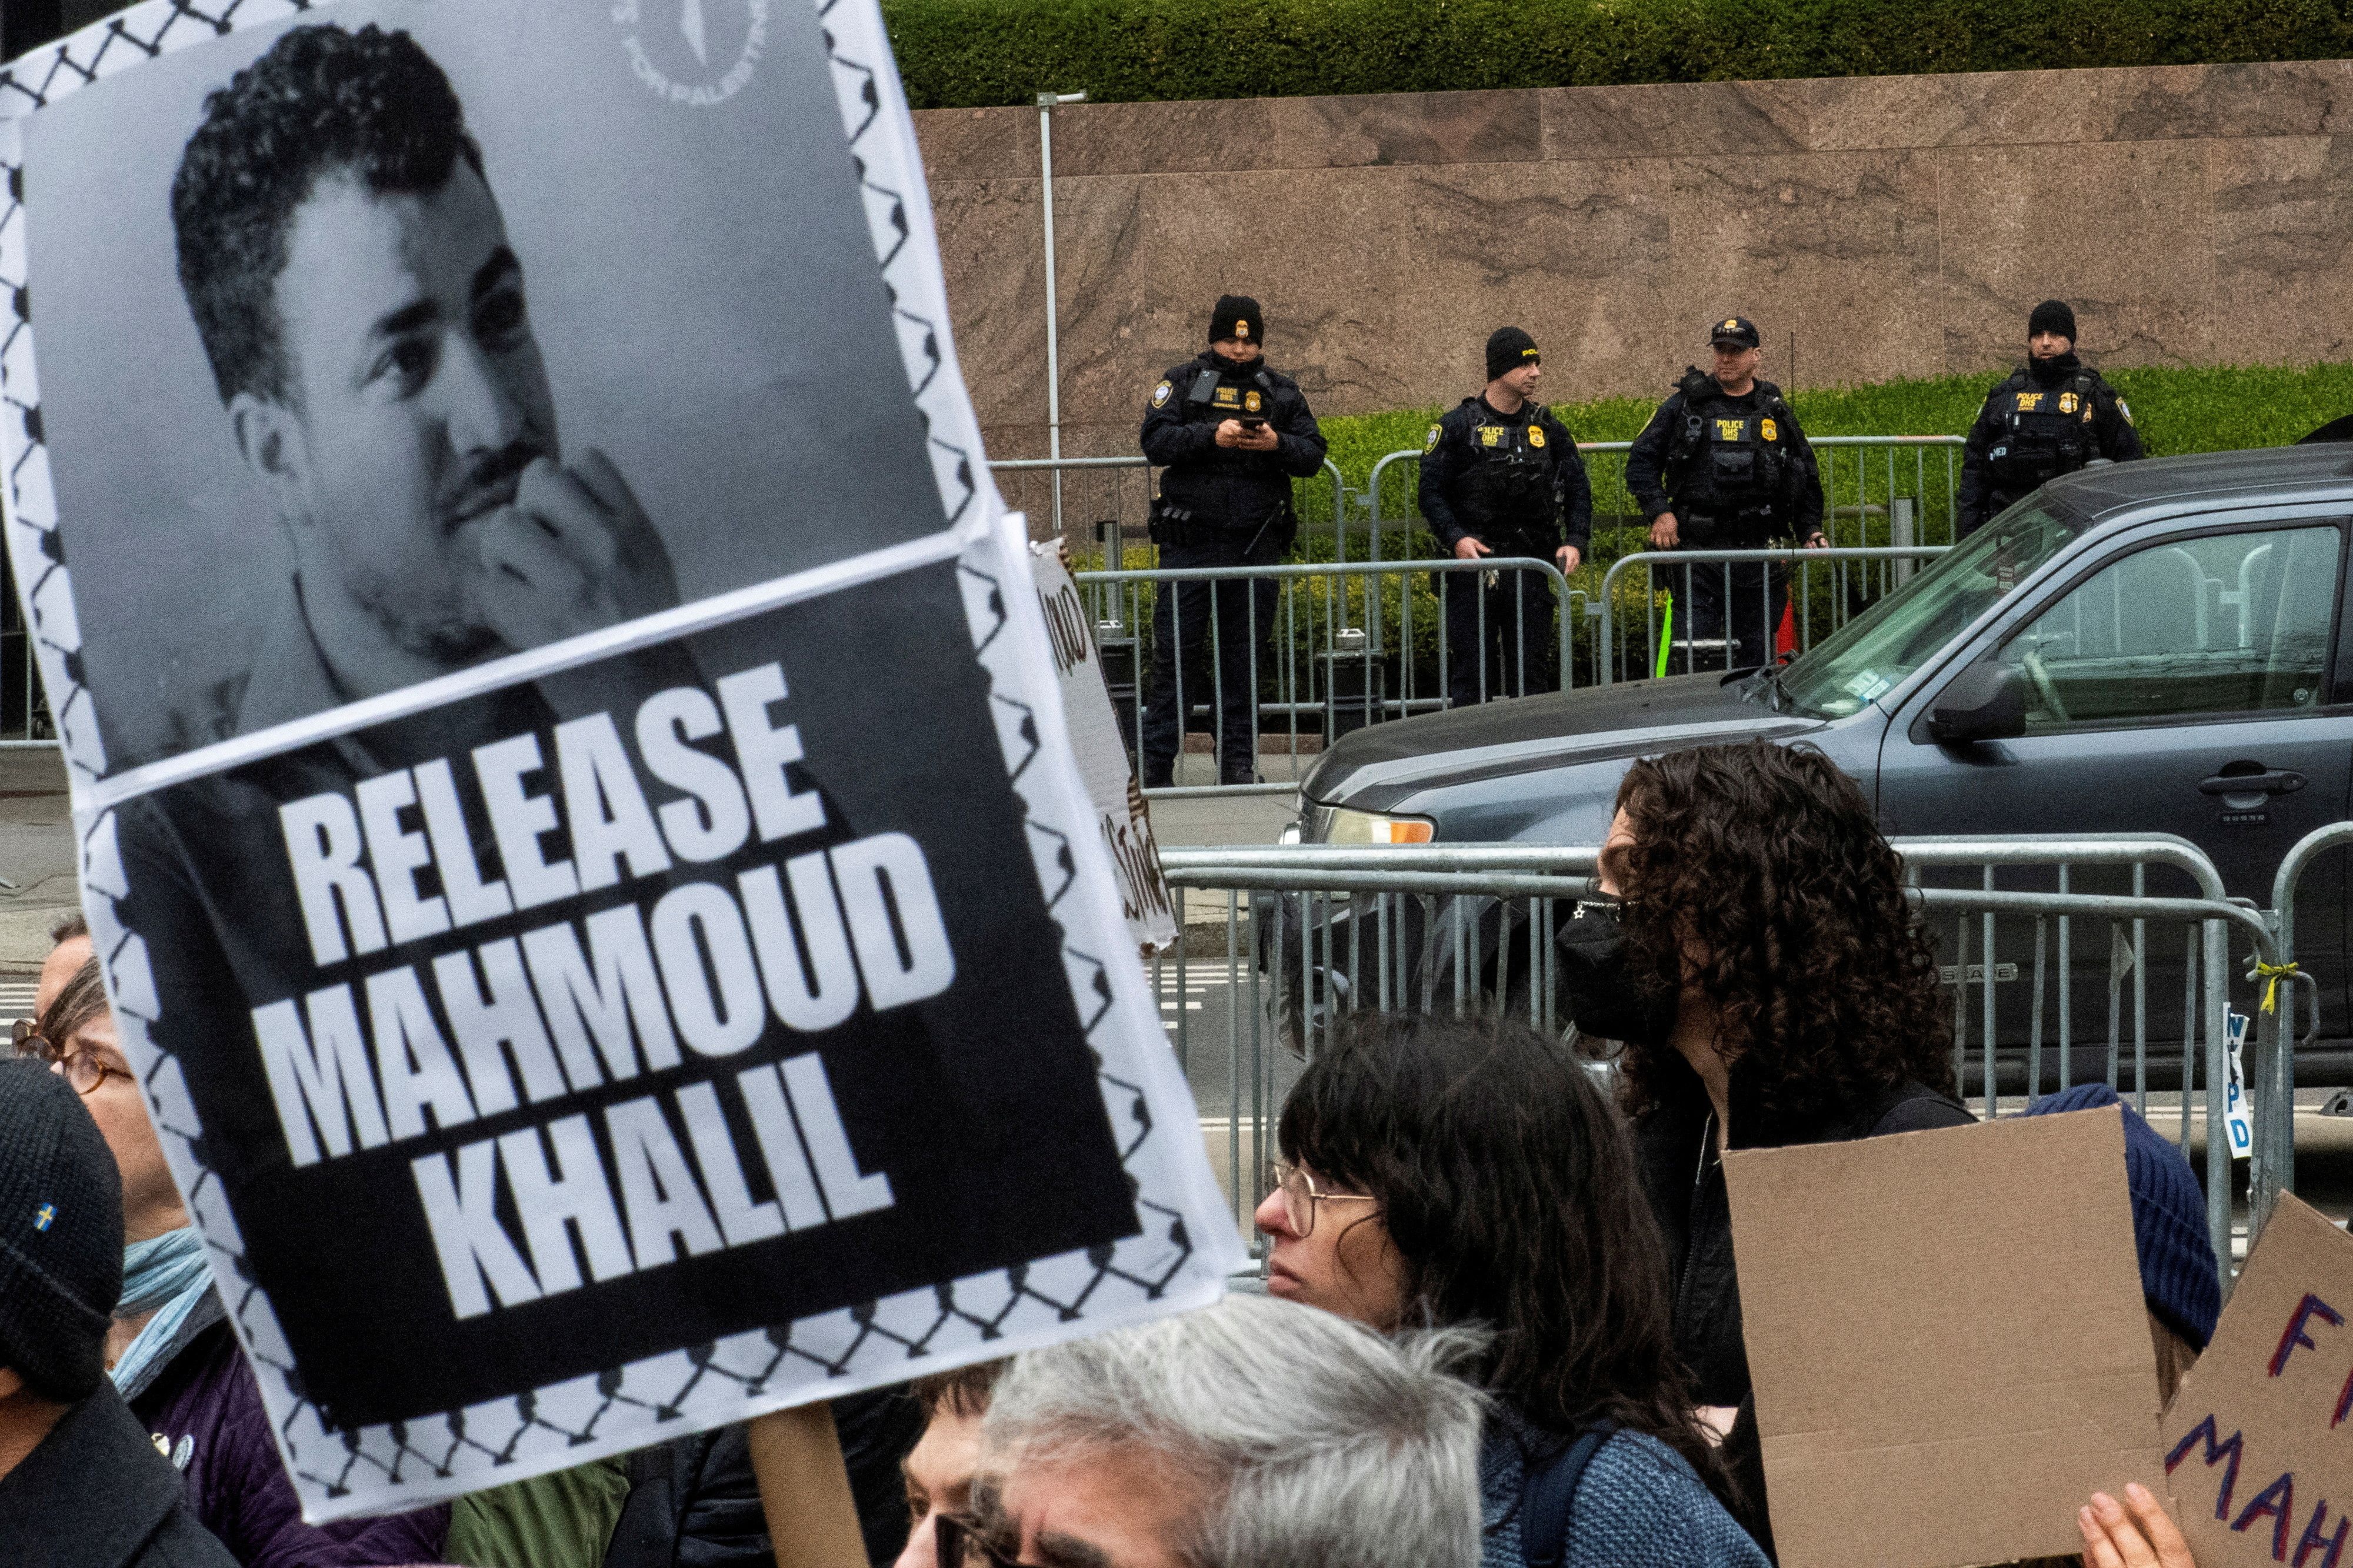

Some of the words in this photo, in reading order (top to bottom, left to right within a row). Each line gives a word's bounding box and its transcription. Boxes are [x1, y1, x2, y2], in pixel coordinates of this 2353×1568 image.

[2016, 392, 2044, 401] POLICE
[2019, 399, 2036, 407] DHS
[1717, 419, 1744, 429] POLICE
[1722, 428, 1738, 436] DHS
[279, 662, 825, 968] RELEASE
[251, 833, 956, 1168] MAHMOUD
[411, 1053, 894, 1320] KHALIL
